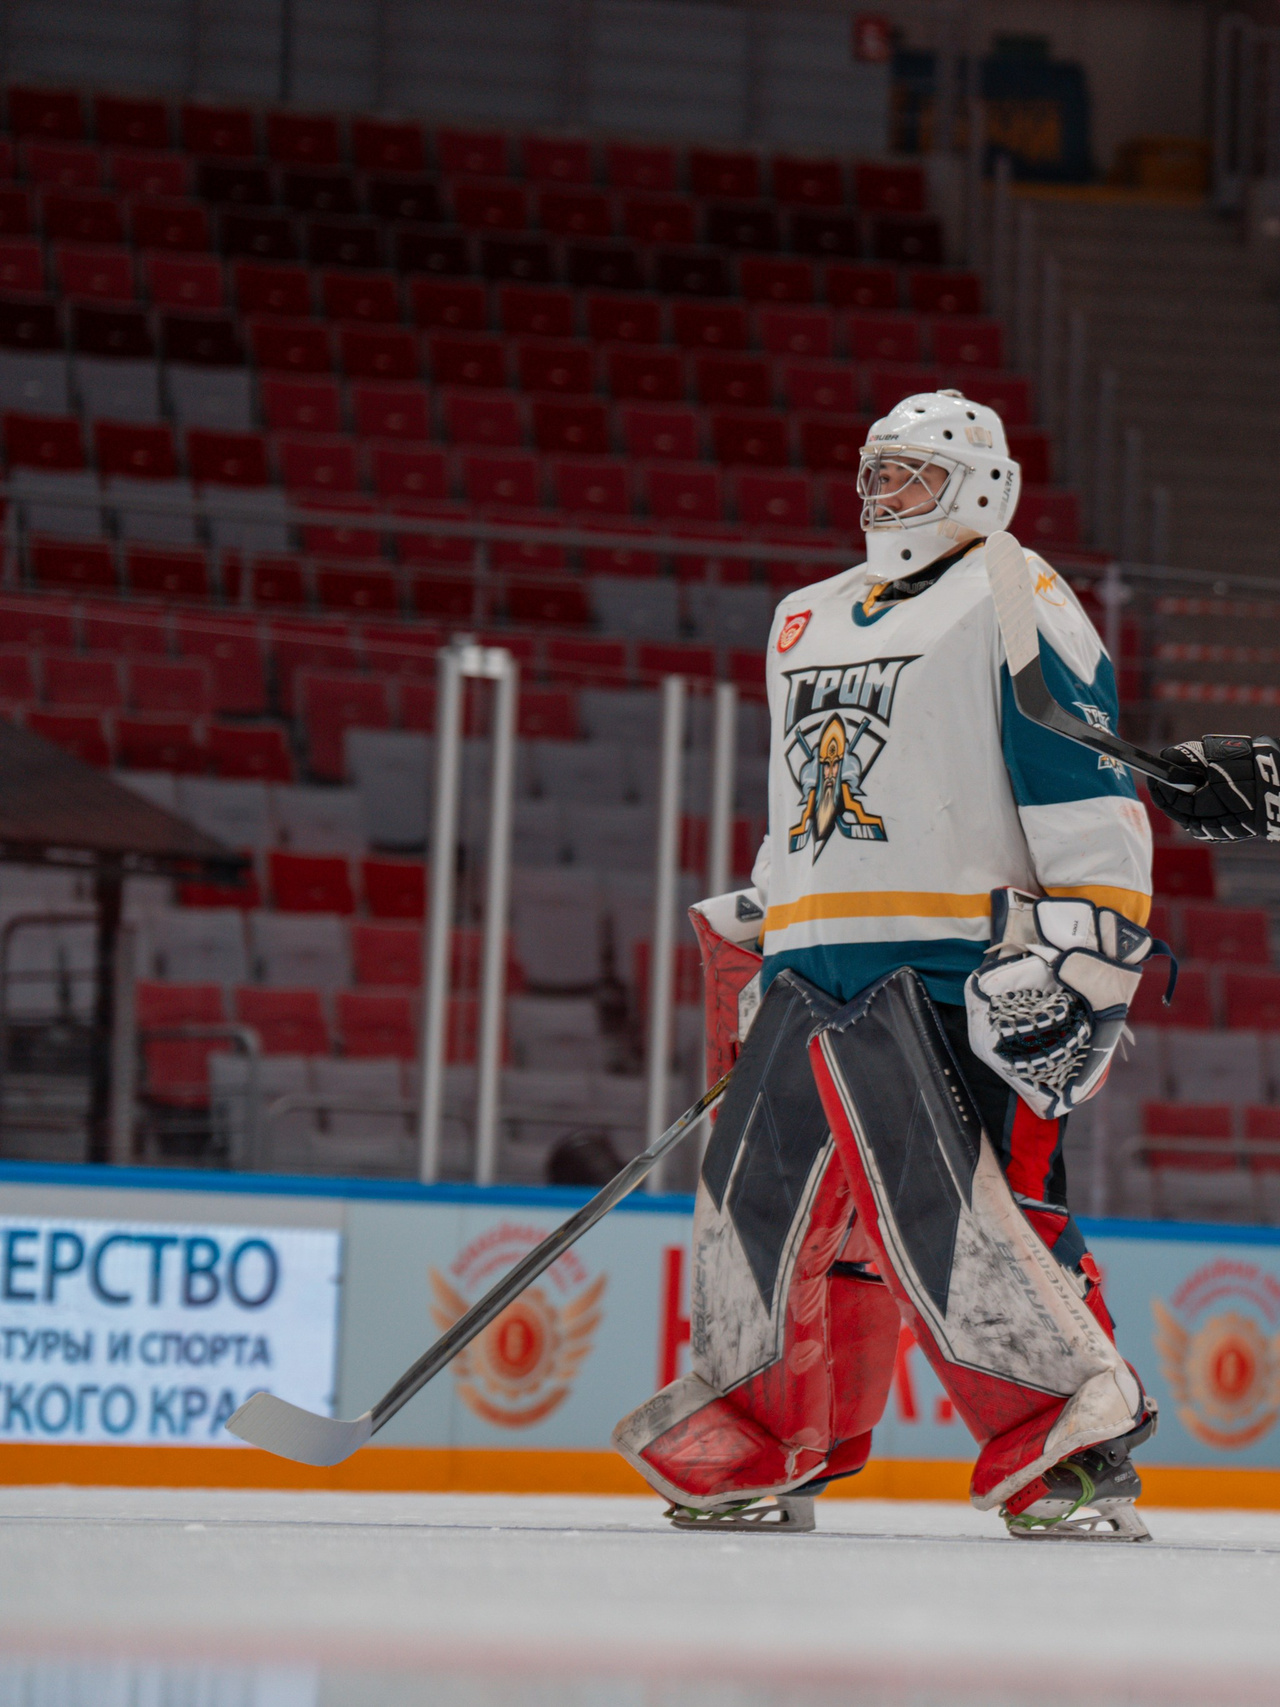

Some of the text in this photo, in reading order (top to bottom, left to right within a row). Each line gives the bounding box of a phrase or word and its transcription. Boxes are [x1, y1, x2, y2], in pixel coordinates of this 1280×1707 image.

[784, 660, 906, 735] ГРОМ
[140, 1331, 272, 1368] СПОРТА
[0, 1383, 272, 1437] КОГО КРА
